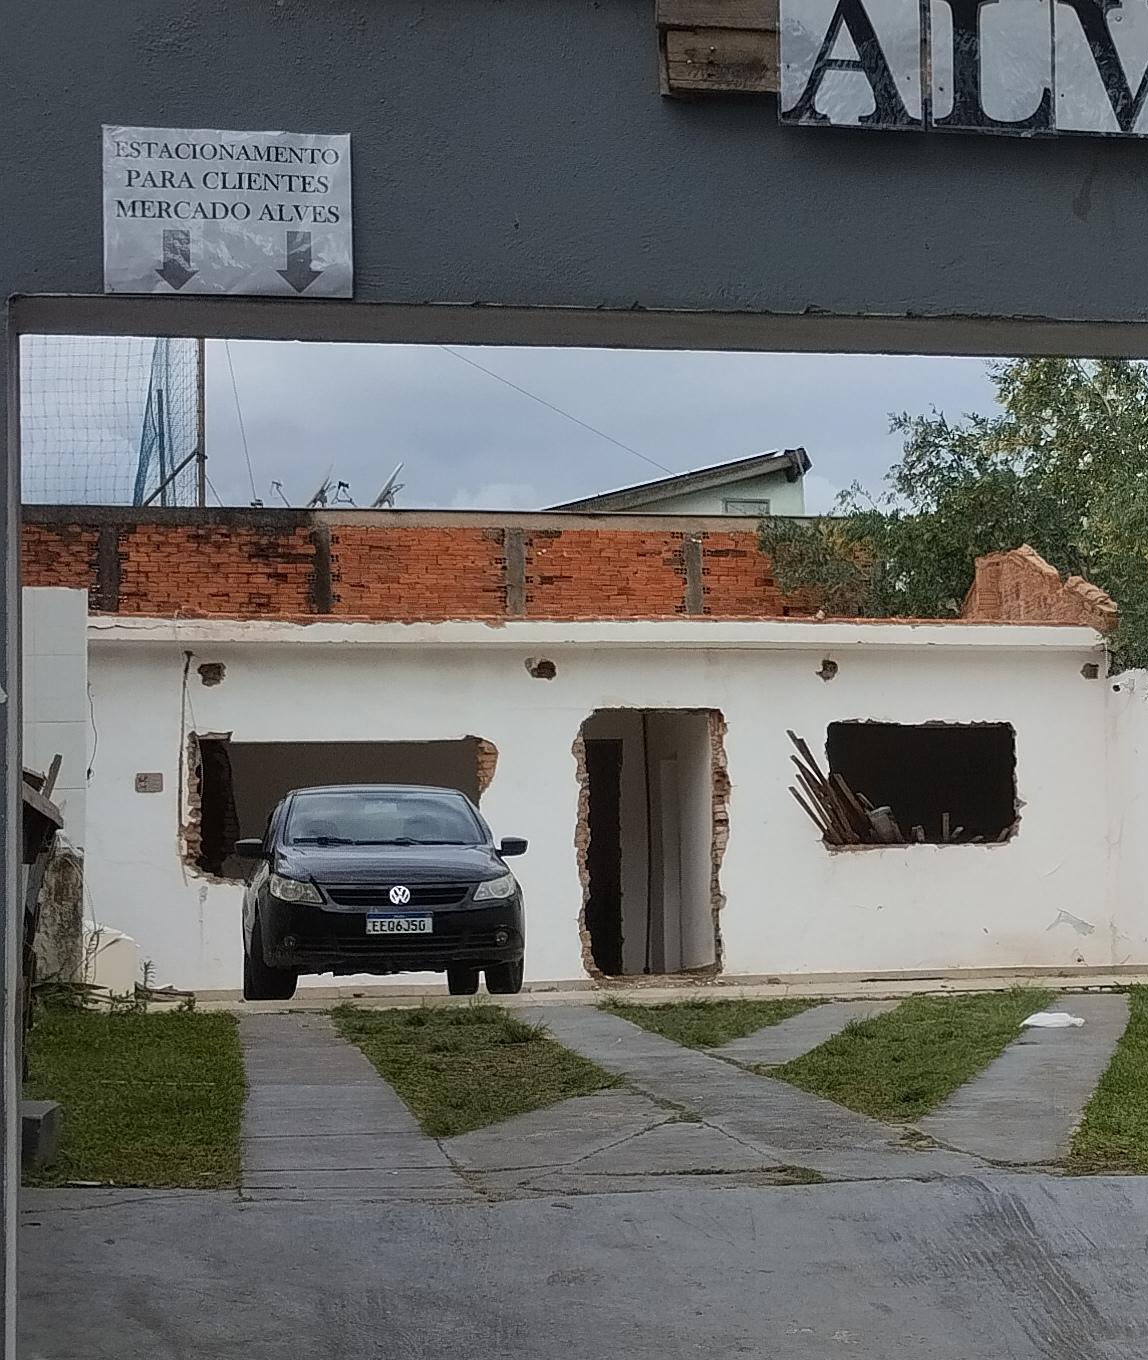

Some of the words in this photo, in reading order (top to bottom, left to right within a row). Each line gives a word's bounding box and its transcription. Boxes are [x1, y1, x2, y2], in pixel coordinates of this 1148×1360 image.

[114, 141, 340, 165] ESTACIONAMENTO
[125, 169, 196, 189] PARA
[202, 171, 329, 194] CLIENTES
[114, 199, 250, 220] MERCADO
[257, 203, 340, 224] ALVES
